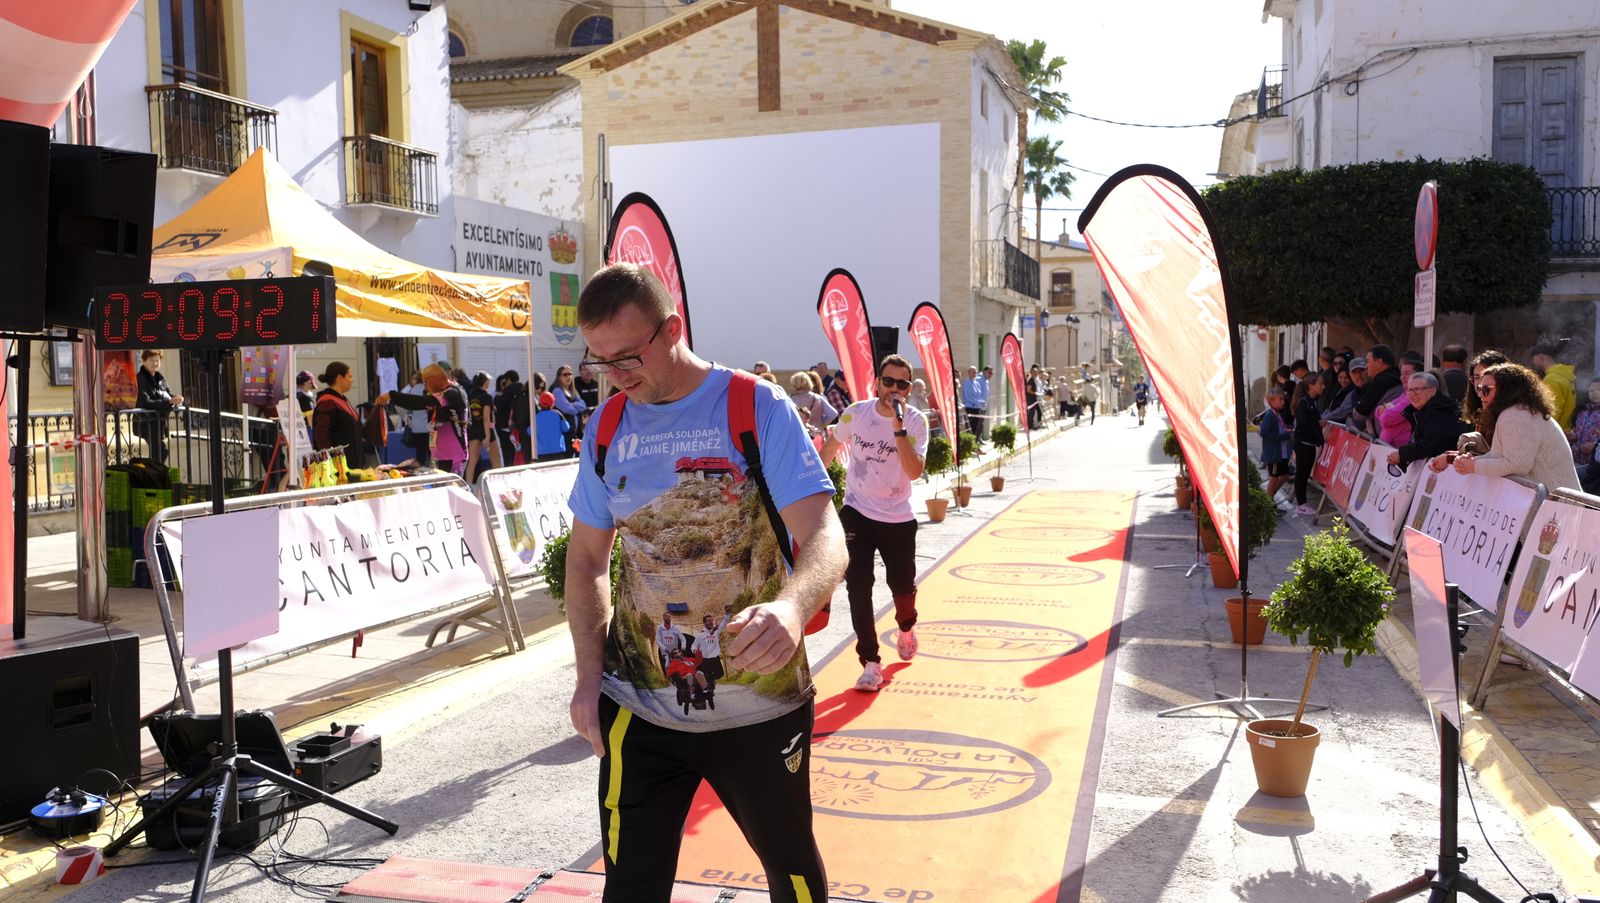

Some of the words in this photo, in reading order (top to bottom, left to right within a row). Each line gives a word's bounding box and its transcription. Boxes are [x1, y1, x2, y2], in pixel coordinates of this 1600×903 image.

[463, 222, 543, 251] EXCELENTÍSIMO
[465, 250, 543, 276] AYUNTAMIENTO
[637, 442, 669, 460] JAIME
[670, 438, 721, 456] JIMÉNEZ
[1439, 489, 1500, 527] AYUNTAMIENTO
[1500, 514, 1517, 535] DE
[279, 521, 436, 565] YUNTAMIENTO
[444, 514, 464, 534] DE
[1427, 508, 1509, 577] CANTORIA
[884, 687, 1038, 703] Ayuntamien
[892, 680, 986, 692] Cantori
[974, 752, 1017, 764] LA
[210, 784, 226, 818] VONYX
[700, 868, 871, 897] Caoria
[882, 887, 934, 903] de
